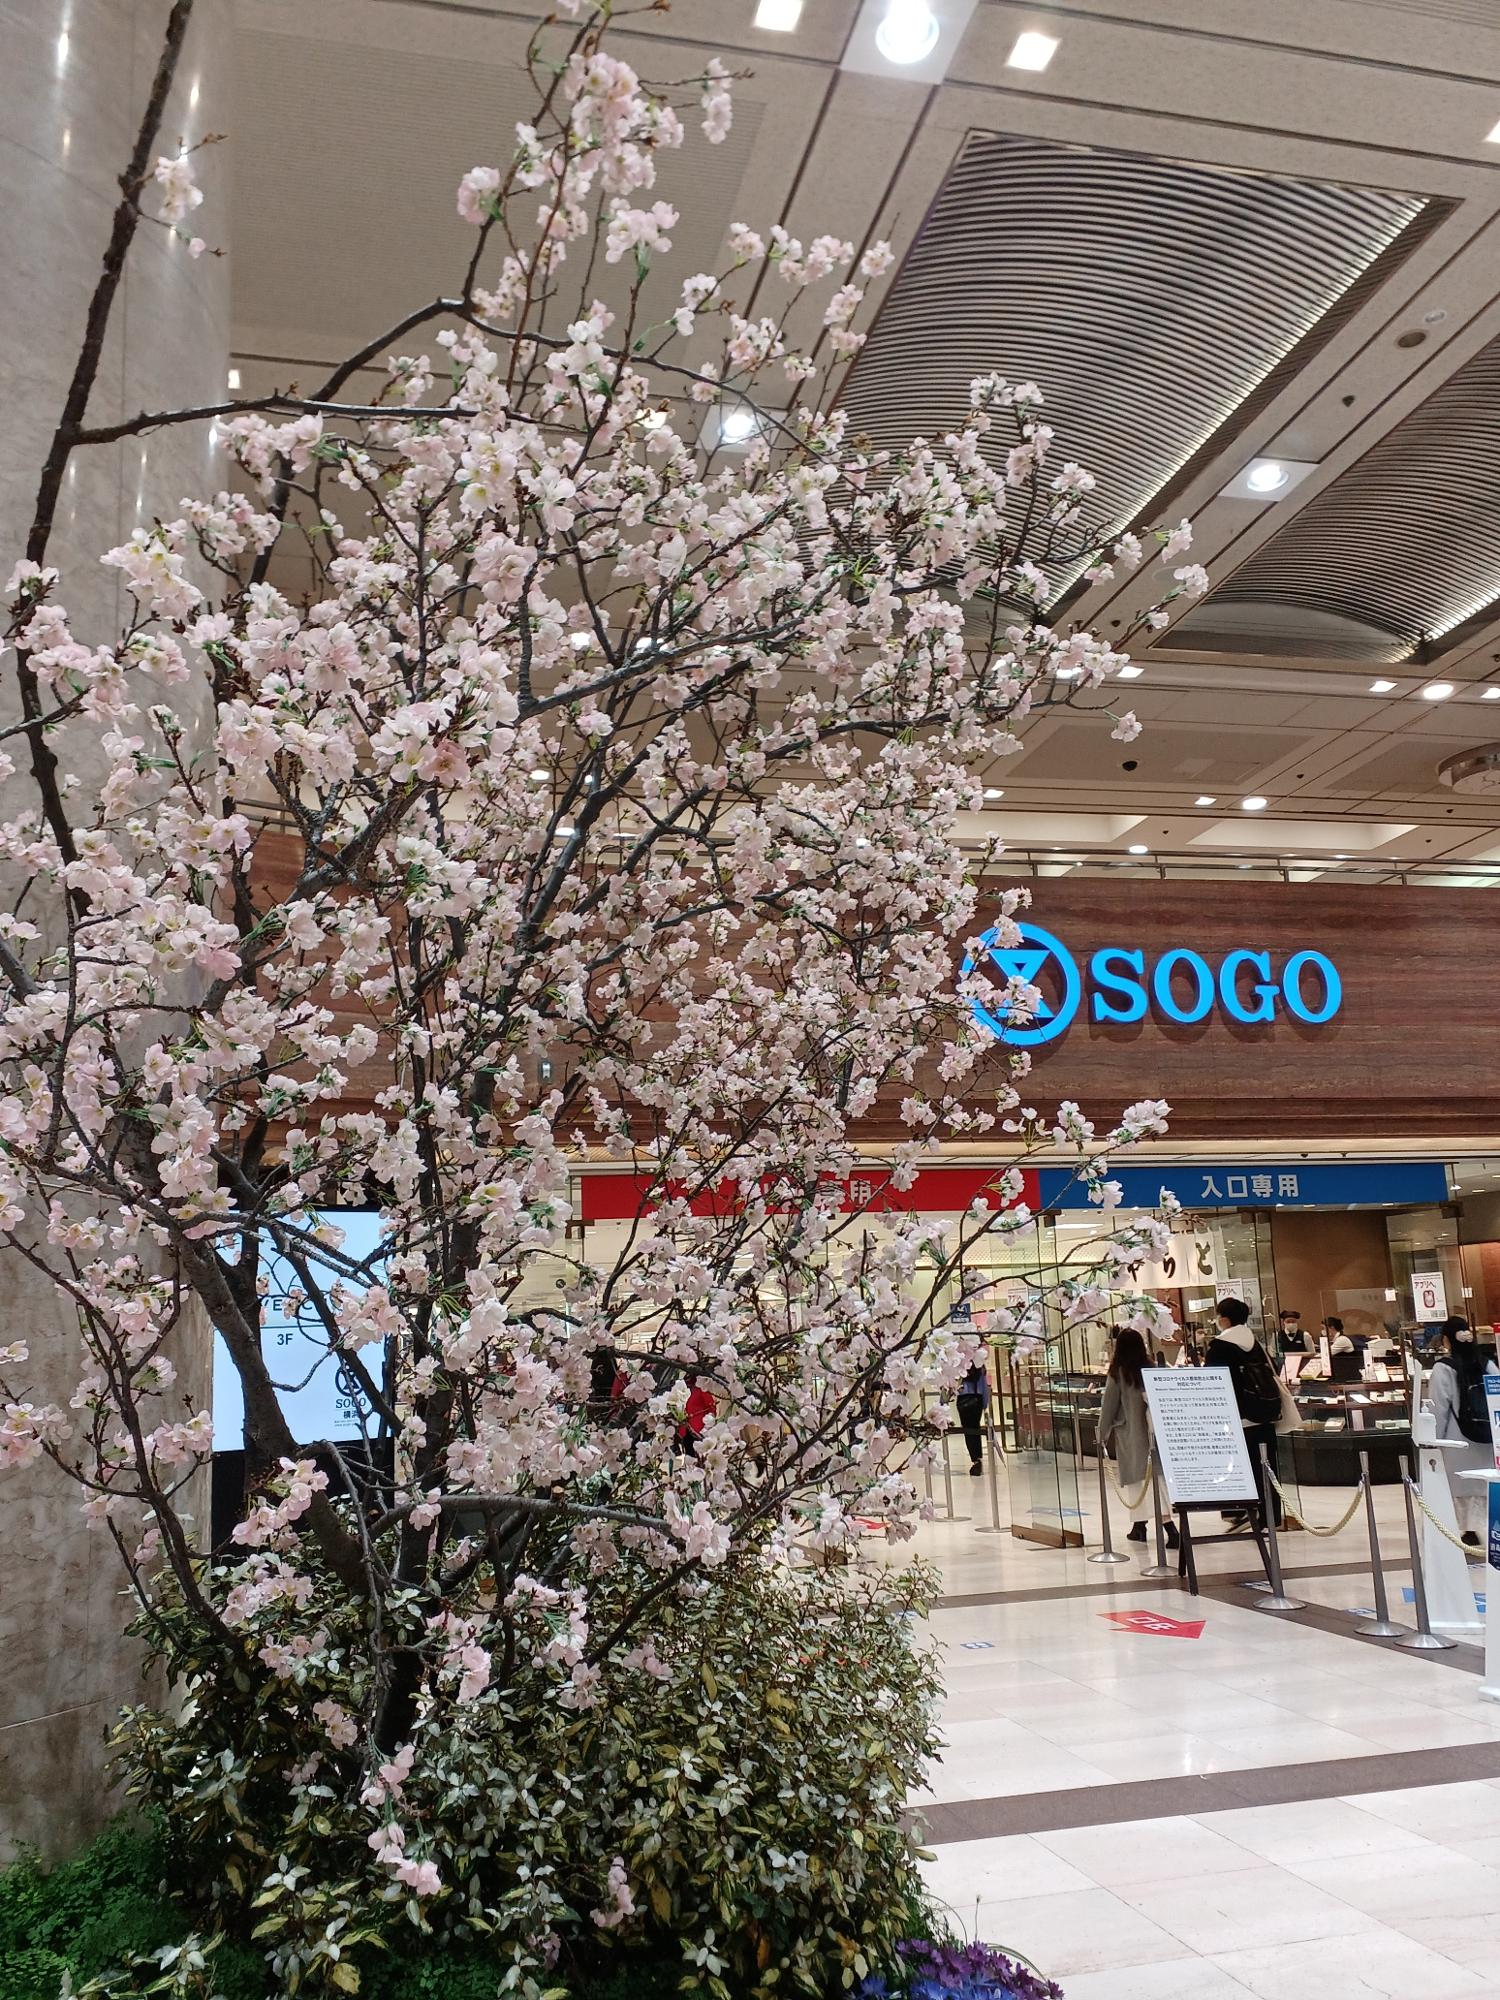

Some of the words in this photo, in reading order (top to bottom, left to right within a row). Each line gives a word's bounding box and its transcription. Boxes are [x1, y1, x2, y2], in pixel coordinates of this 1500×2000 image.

[1091, 948, 1343, 1024] SOGO
[1200, 1174, 1300, 1199] 入口専用
[277, 1333, 293, 1345] 3F
